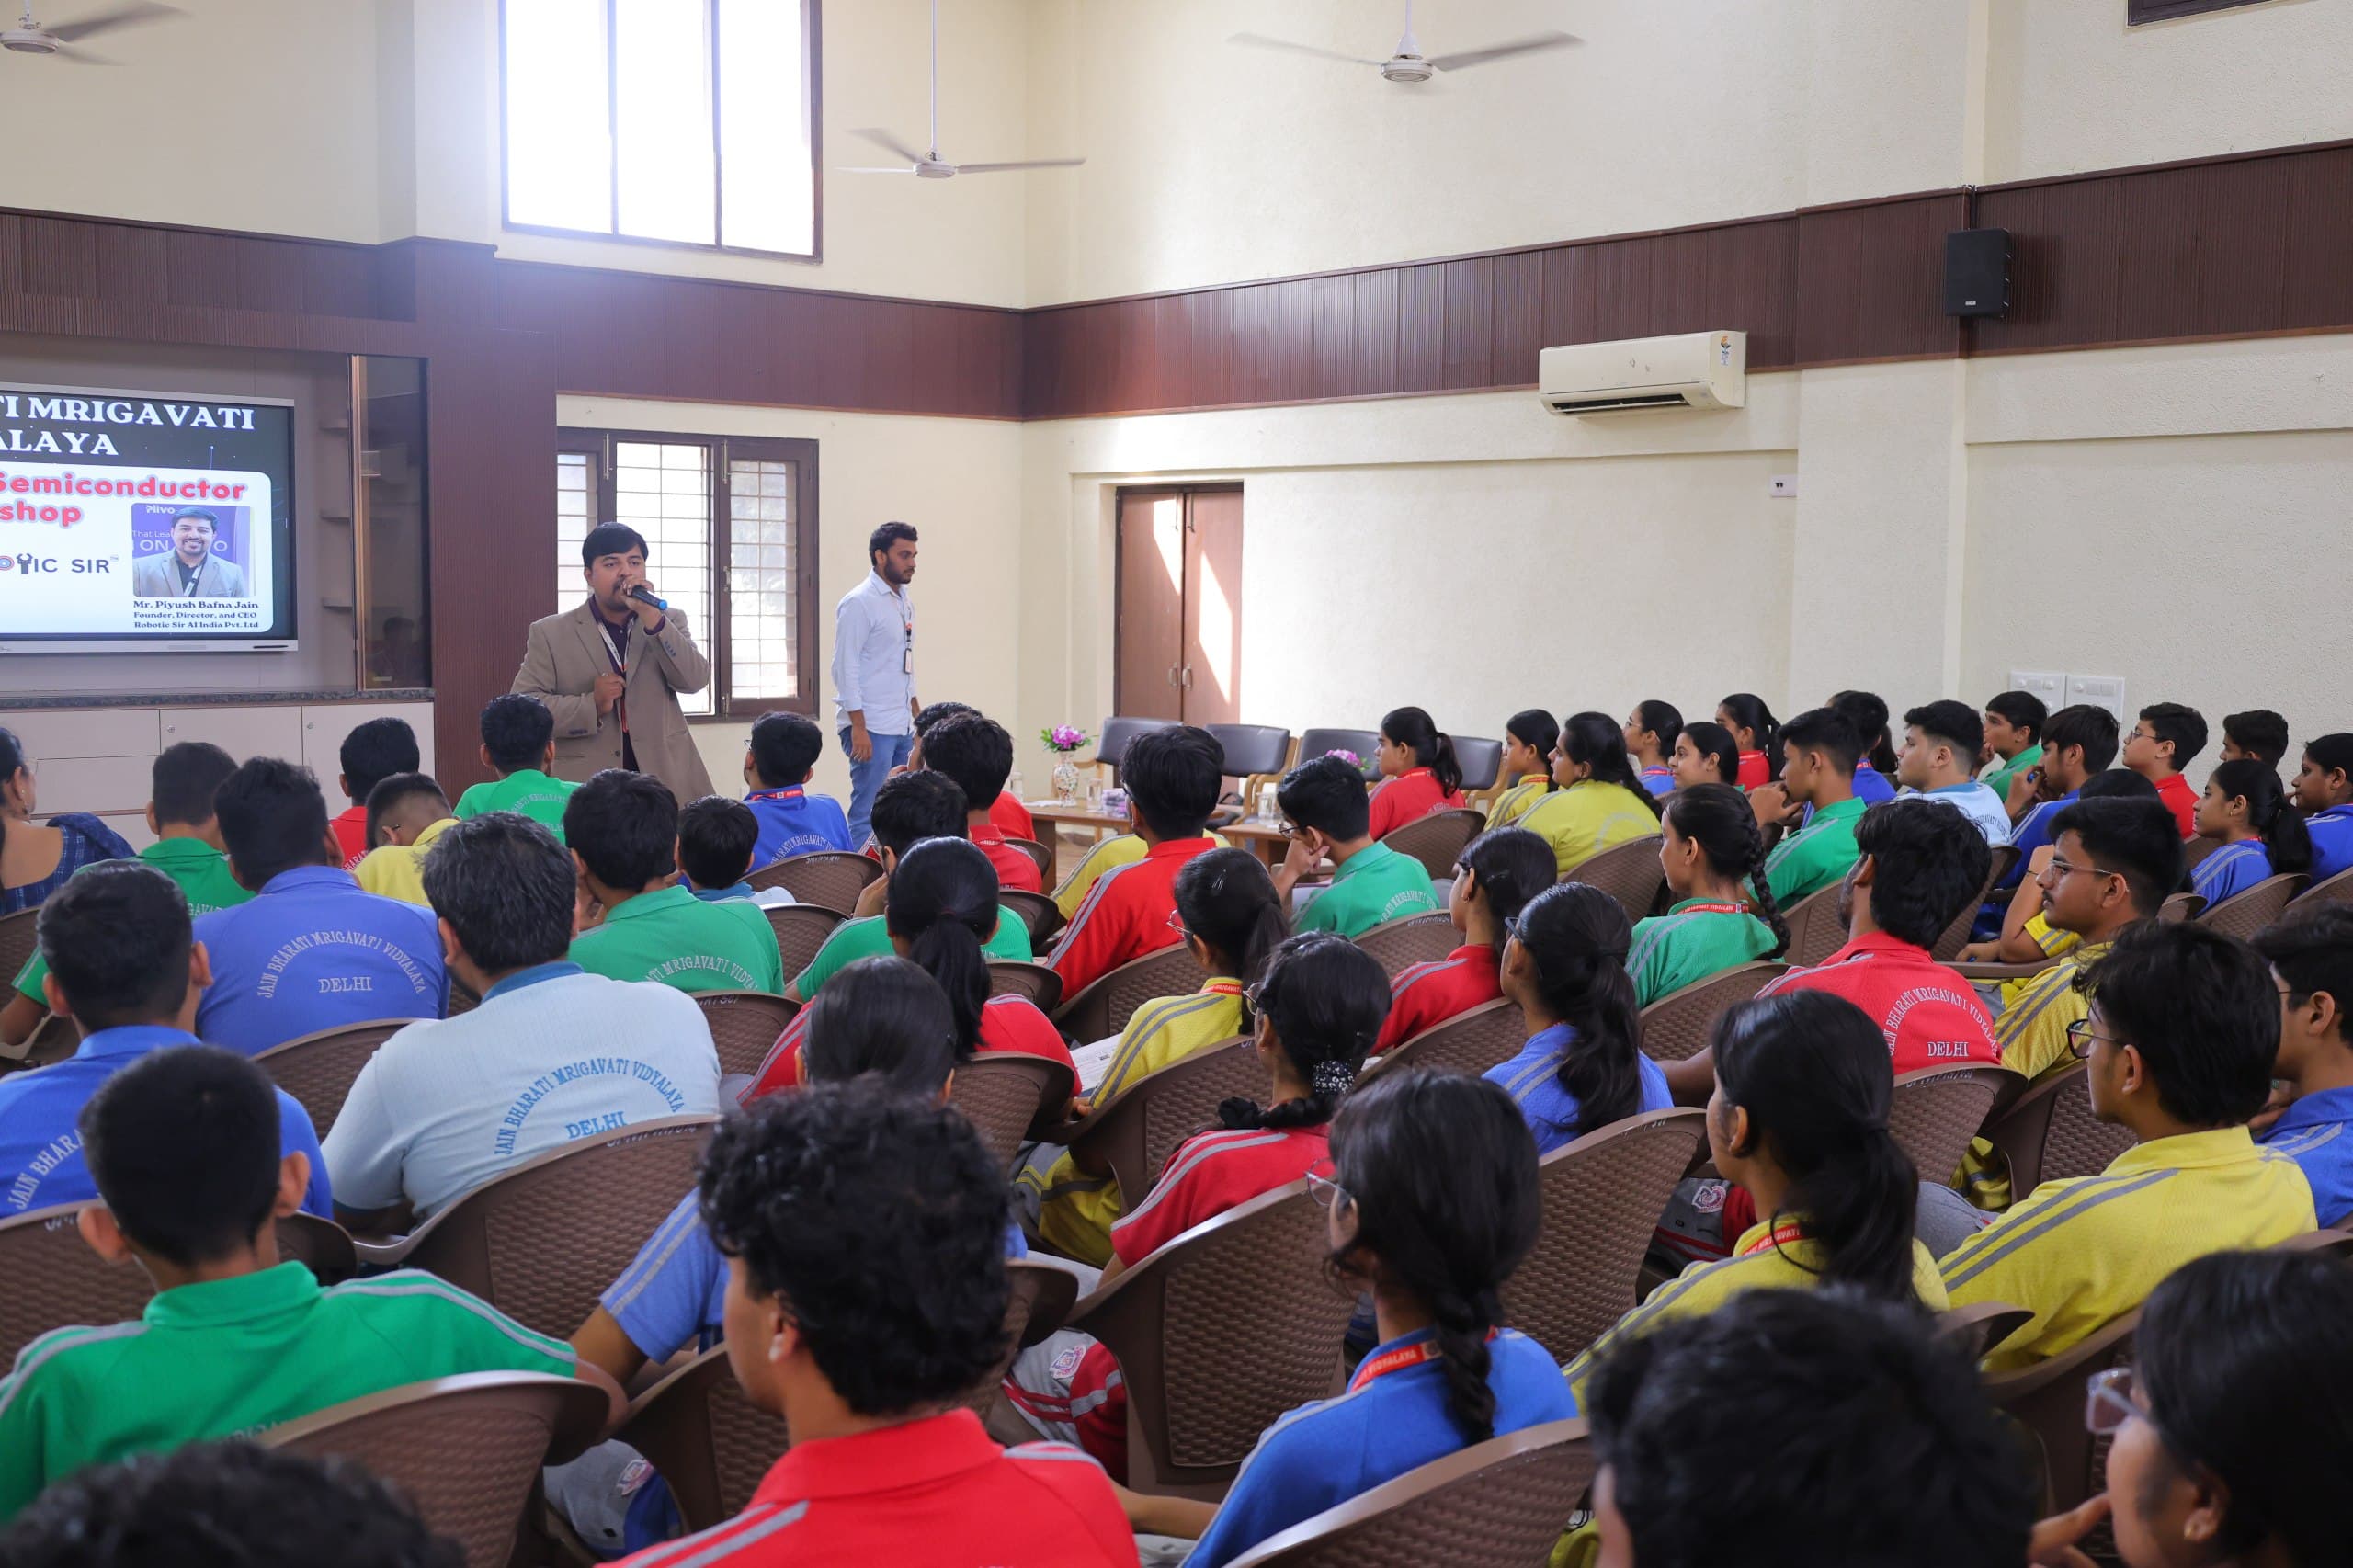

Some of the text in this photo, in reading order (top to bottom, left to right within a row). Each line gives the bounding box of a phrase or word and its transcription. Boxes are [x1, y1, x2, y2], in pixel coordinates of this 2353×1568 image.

[0, 396, 255, 429] I MRIGAVATI
[71, 559, 110, 573] SIR
[155, 601, 196, 609] Piyush
[257, 929, 427, 999] JAIN BHARATI MRIGAVATI VIDYALAYA
[662, 955, 730, 976] MRIGAVATI
[318, 976, 373, 993] DELHI
[1886, 989, 1918, 1029] BHARATI
[1912, 986, 1968, 1010] MRIGAVATI
[1927, 1041, 1969, 1057] DELHI
[494, 1058, 685, 1154] JAIN BHARATI MRIGAVATI VIDYALAYA
[564, 1110, 628, 1139] DELHI
[7, 1172, 40, 1210] JAIN
